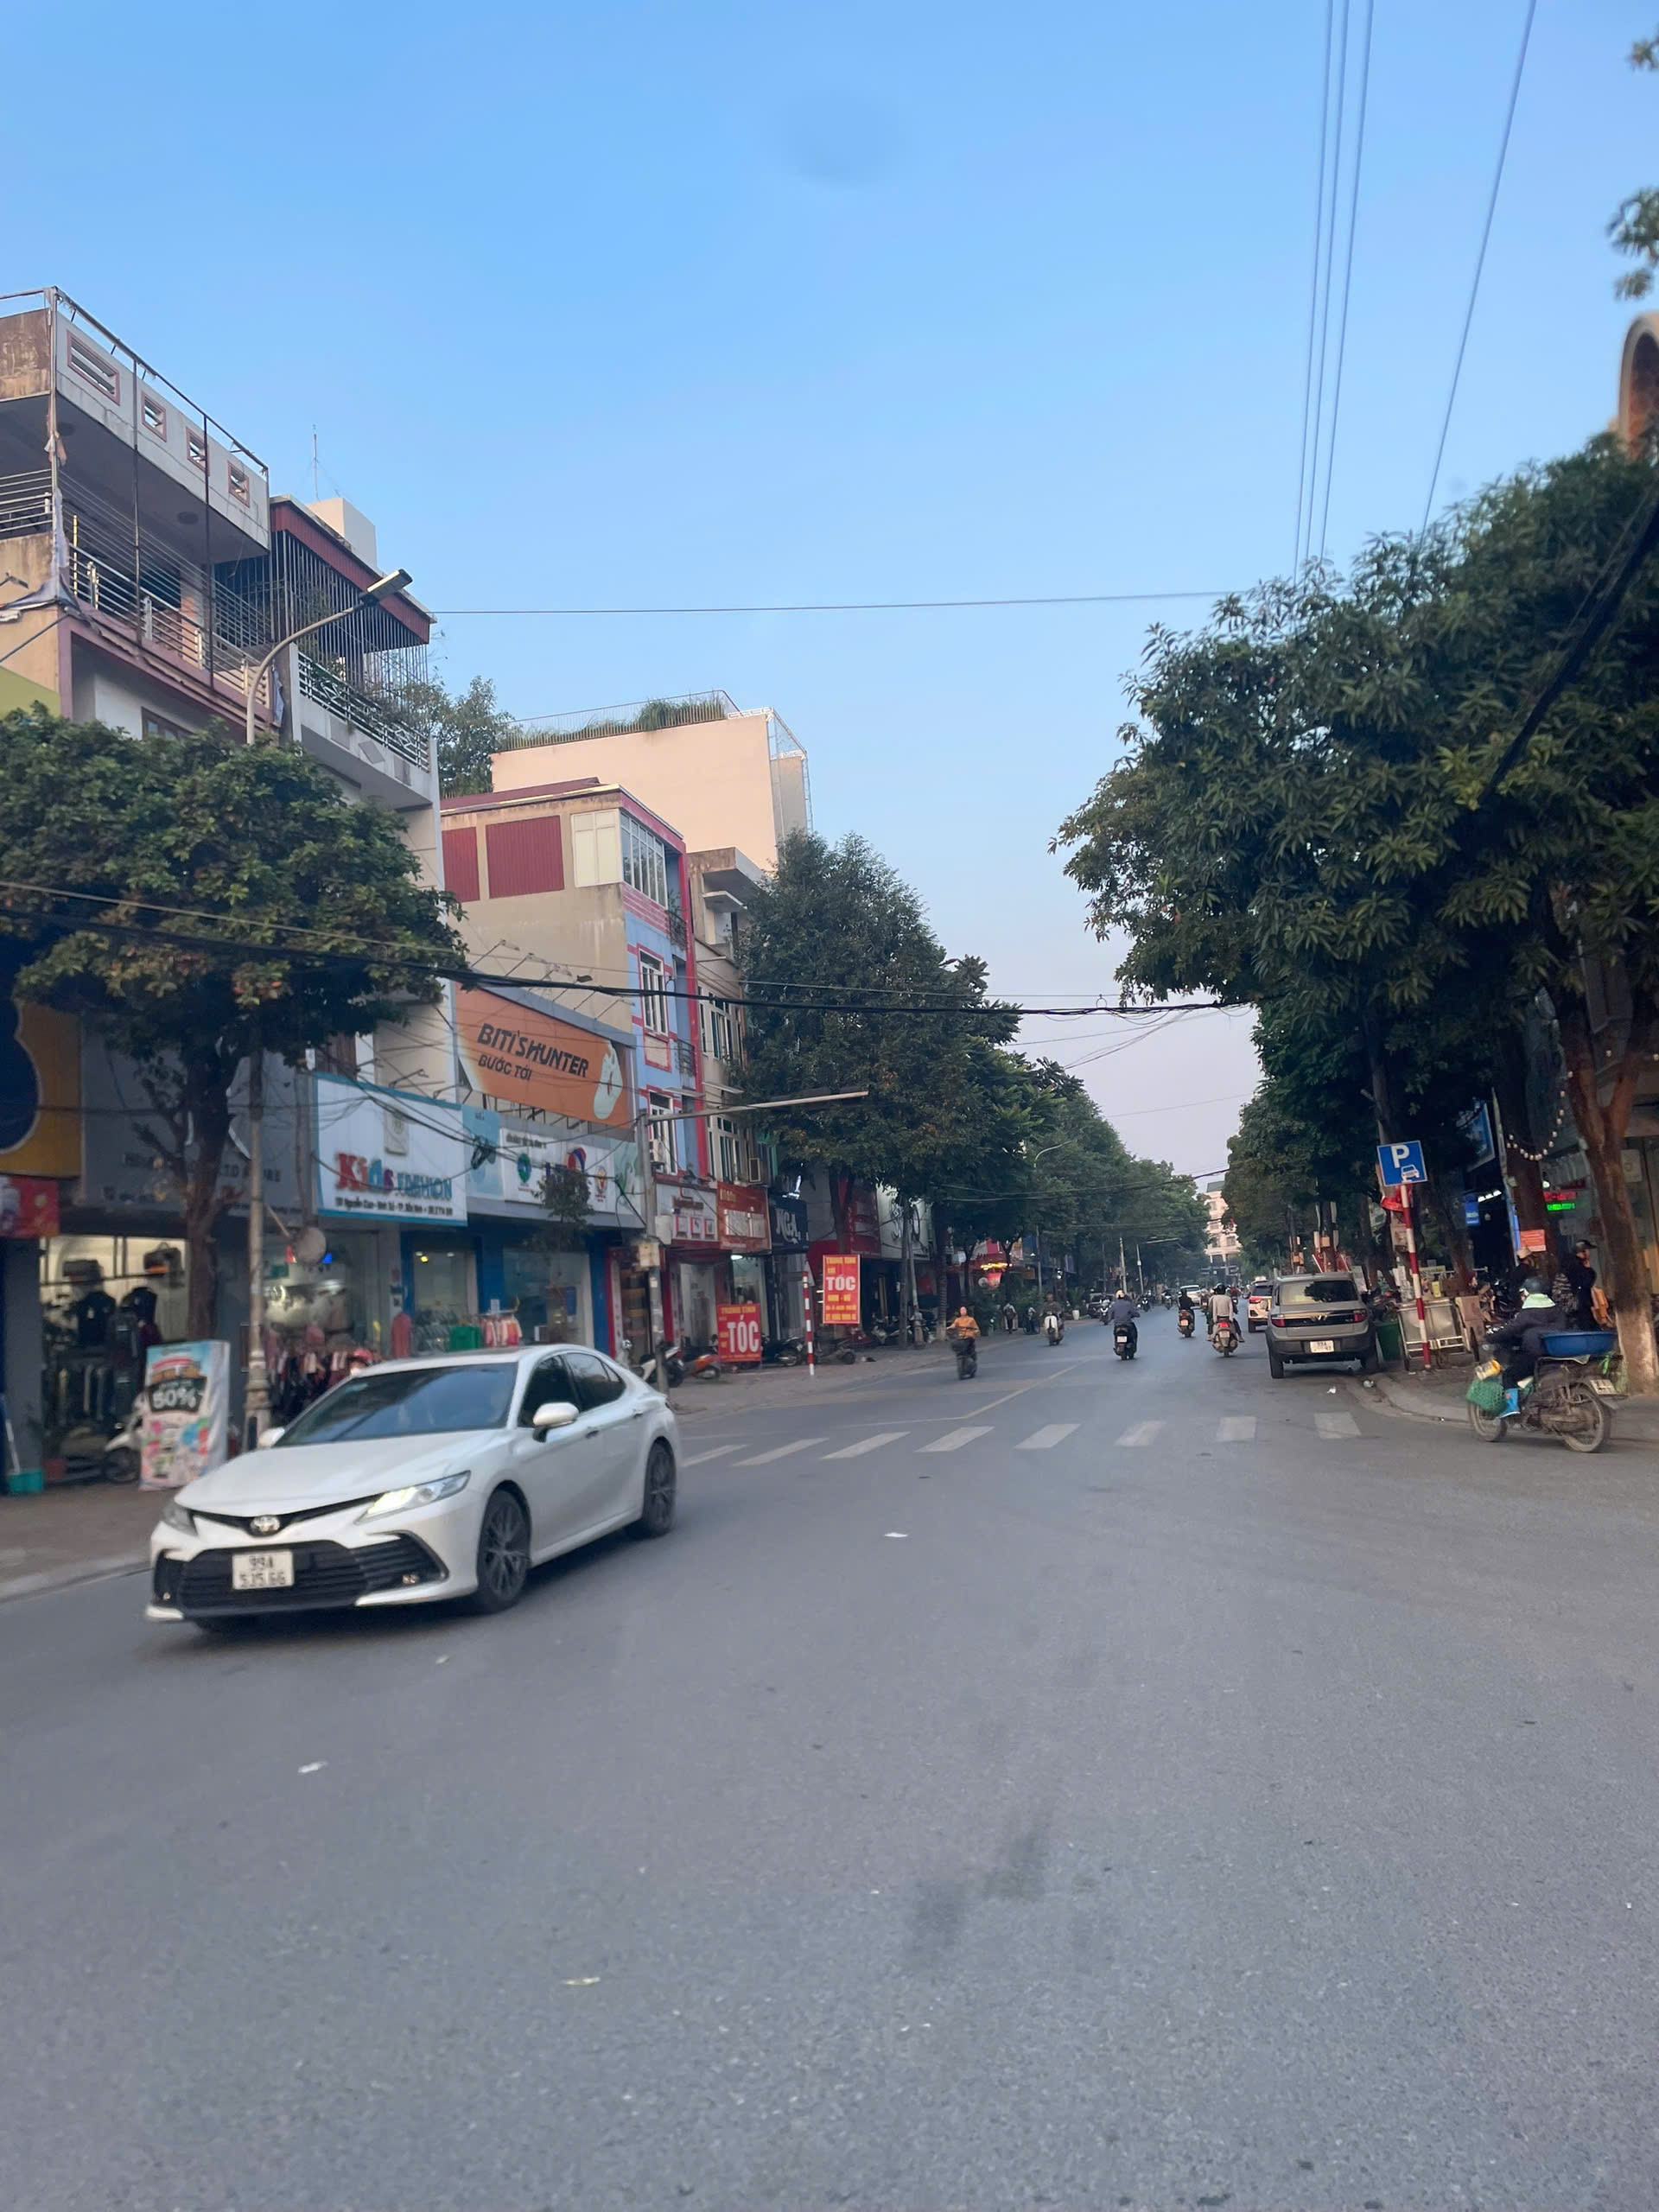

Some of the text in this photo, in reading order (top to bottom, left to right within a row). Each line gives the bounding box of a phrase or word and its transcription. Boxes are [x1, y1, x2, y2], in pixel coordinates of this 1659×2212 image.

[477, 1023, 588, 1077] BITI'S HUNTER
[478, 1054, 532, 1081] BƯỚC TỚI
[1391, 1144, 1410, 1168] P
[825, 1274, 856, 1291] TÓC
[727, 1313, 760, 1354] TÓC
[152, 1386, 197, 1409] 50%
